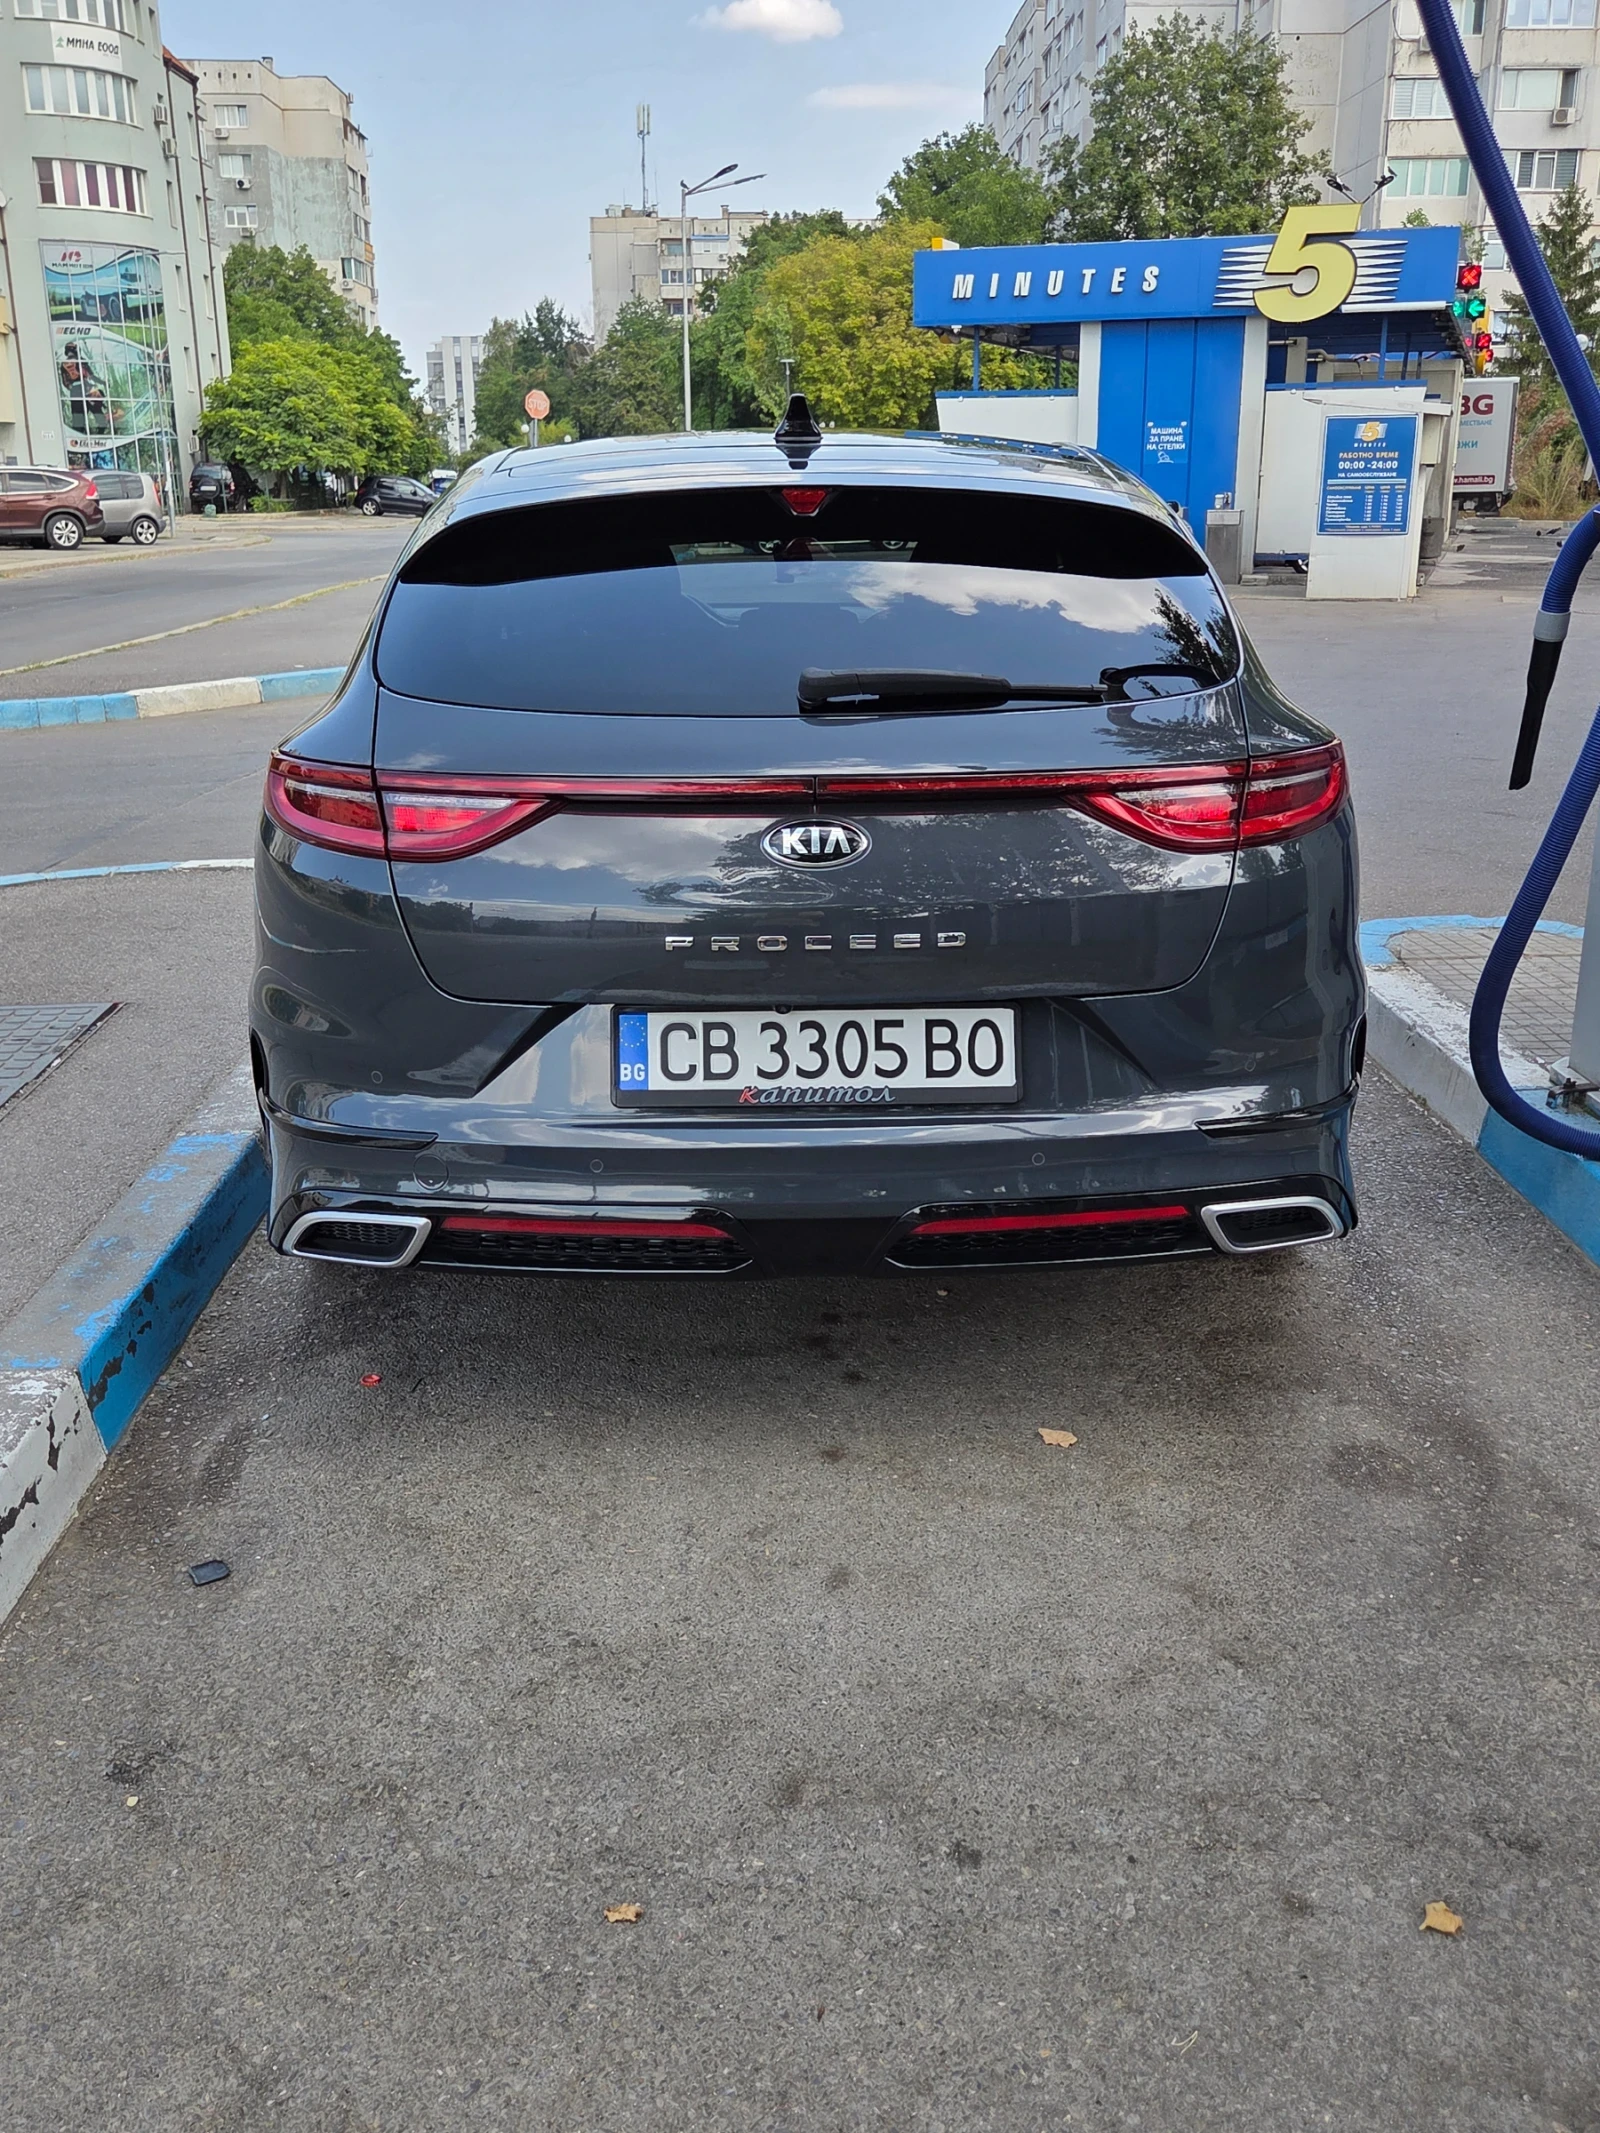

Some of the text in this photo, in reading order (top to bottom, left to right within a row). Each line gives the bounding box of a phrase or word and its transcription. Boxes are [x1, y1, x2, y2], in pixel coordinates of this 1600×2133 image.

[66, 37, 119, 55] МИНА ЕООД
[1254, 204, 1362, 323] 5
[952, 266, 1160, 299] MINUTES
[528, 398, 547, 410] STOP
[1361, 421, 1380, 441] 5
[1338, 461, 1365, 469] 00:00
[1376, 451, 1399, 459] ВРЕМЕ
[782, 827, 851, 854] KIA
[665, 931, 967, 951] PROCEED
[660, 1018, 1003, 1082] CB 3305 BO
[620, 1063, 646, 1081] BG
